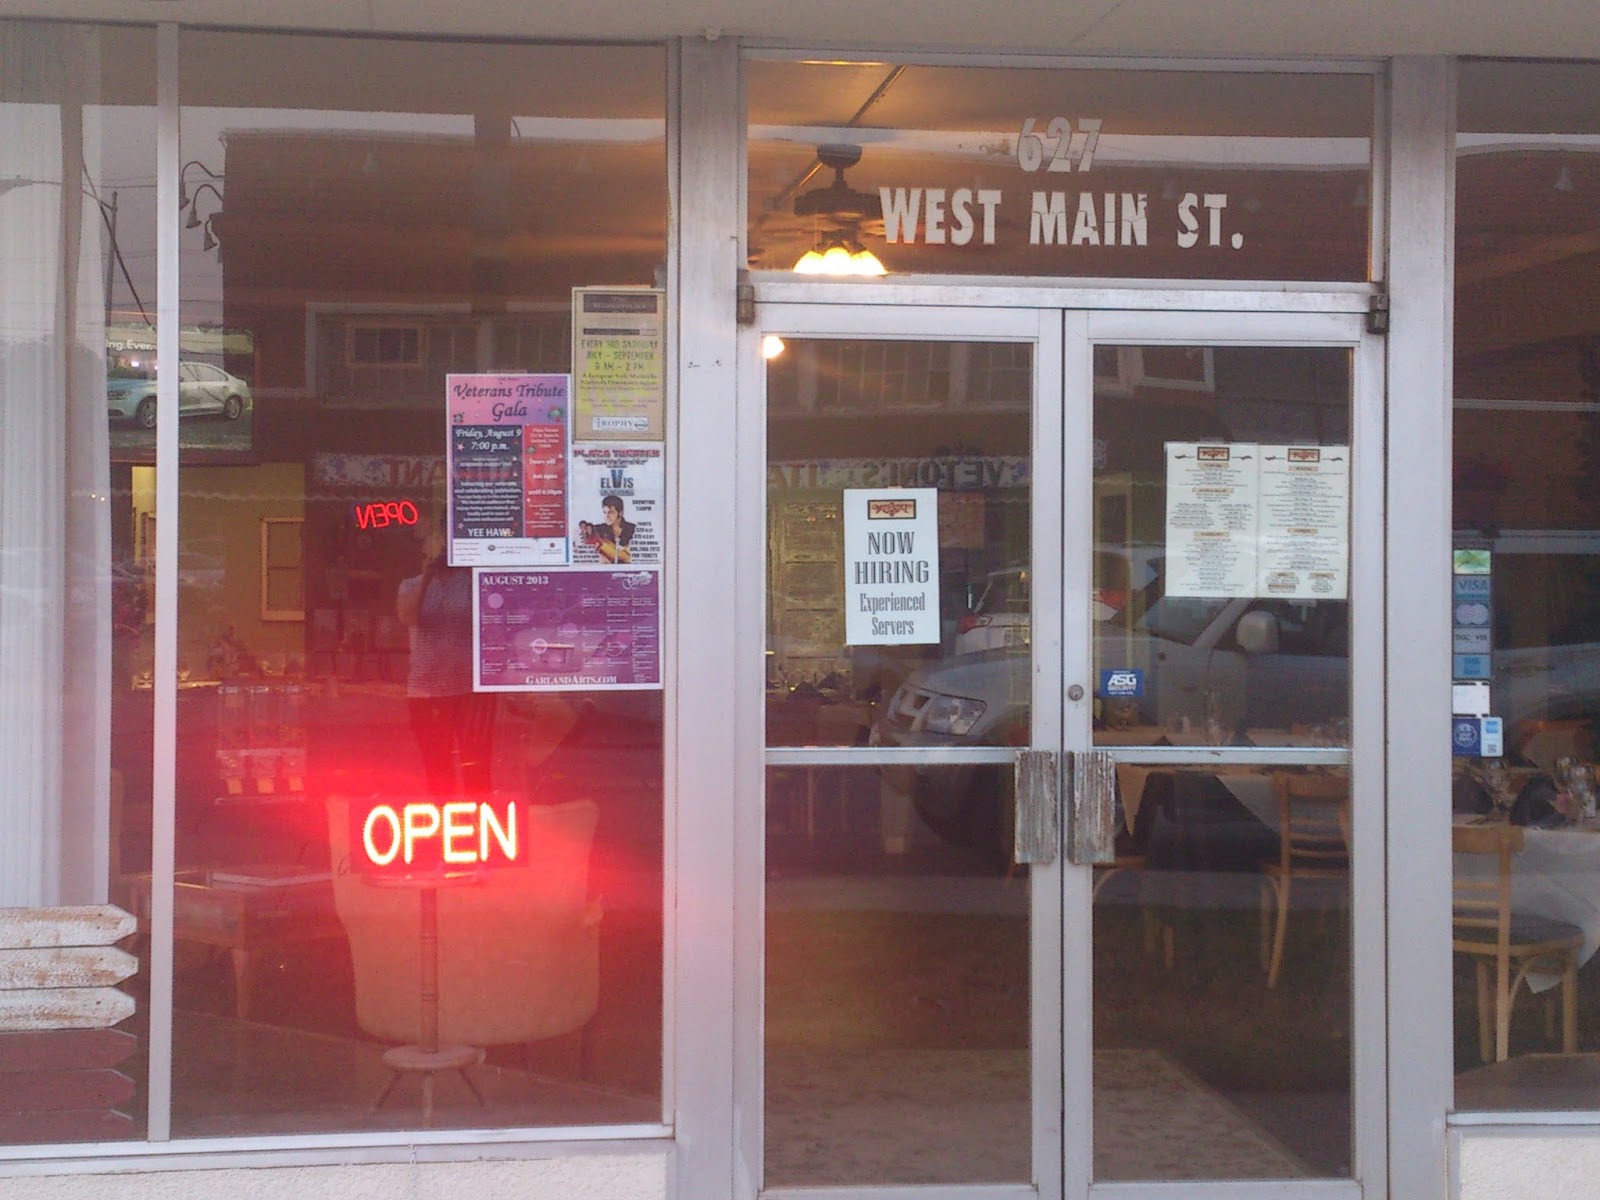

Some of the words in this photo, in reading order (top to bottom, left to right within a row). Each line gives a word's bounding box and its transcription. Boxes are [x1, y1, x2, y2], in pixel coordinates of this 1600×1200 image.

[1017, 117, 1102, 172] 627
[879, 187, 1001, 246] WEST
[1029, 191, 1147, 246] MAIN
[1177, 193, 1244, 249] ST.
[613, 351, 654, 360] SEPTEMBER
[453, 383, 513, 398] Veterans
[515, 383, 565, 398] Tribute
[492, 402, 528, 422] Gala
[455, 428, 484, 439] Friday,
[484, 428, 515, 439] August
[516, 429, 522, 437] 9
[471, 441, 490, 450] 7:00
[491, 443, 510, 452] p.m.
[600, 469, 634, 489] ELVIS
[467, 528, 484, 537] YEE
[867, 531, 915, 555] NOW
[481, 576, 525, 585] AUGUST
[526, 576, 549, 585] 2013
[854, 560, 929, 584] HIRING
[1458, 580, 1488, 591] VISA
[860, 592, 926, 615] Experienced
[872, 617, 914, 636] Servers
[1108, 674, 1137, 686] ASG
[363, 801, 517, 866] OPEN
